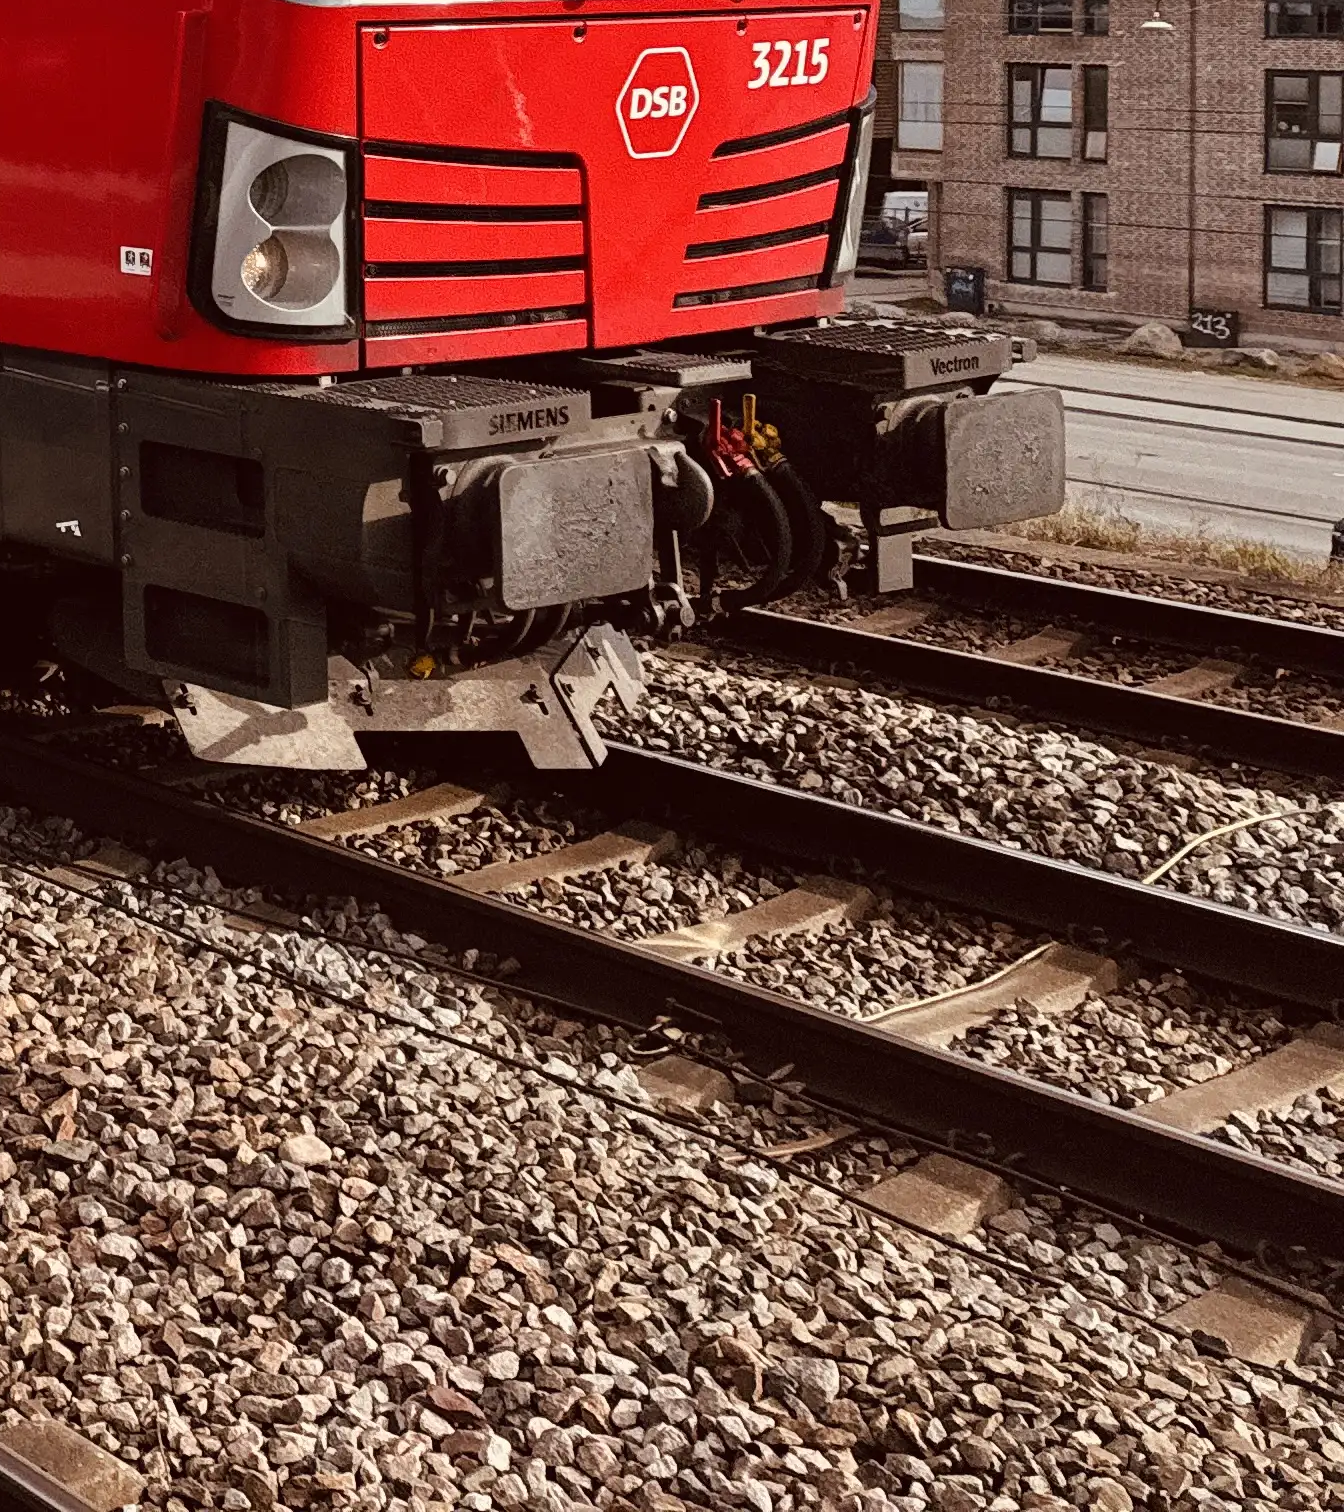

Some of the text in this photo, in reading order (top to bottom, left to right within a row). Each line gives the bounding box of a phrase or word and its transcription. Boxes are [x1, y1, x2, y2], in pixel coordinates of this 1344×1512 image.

[747, 37, 830, 90] 3215
[629, 85, 688, 120] DSB
[930, 355, 980, 376] Vectron
[488, 405, 571, 436] SIEMENS
